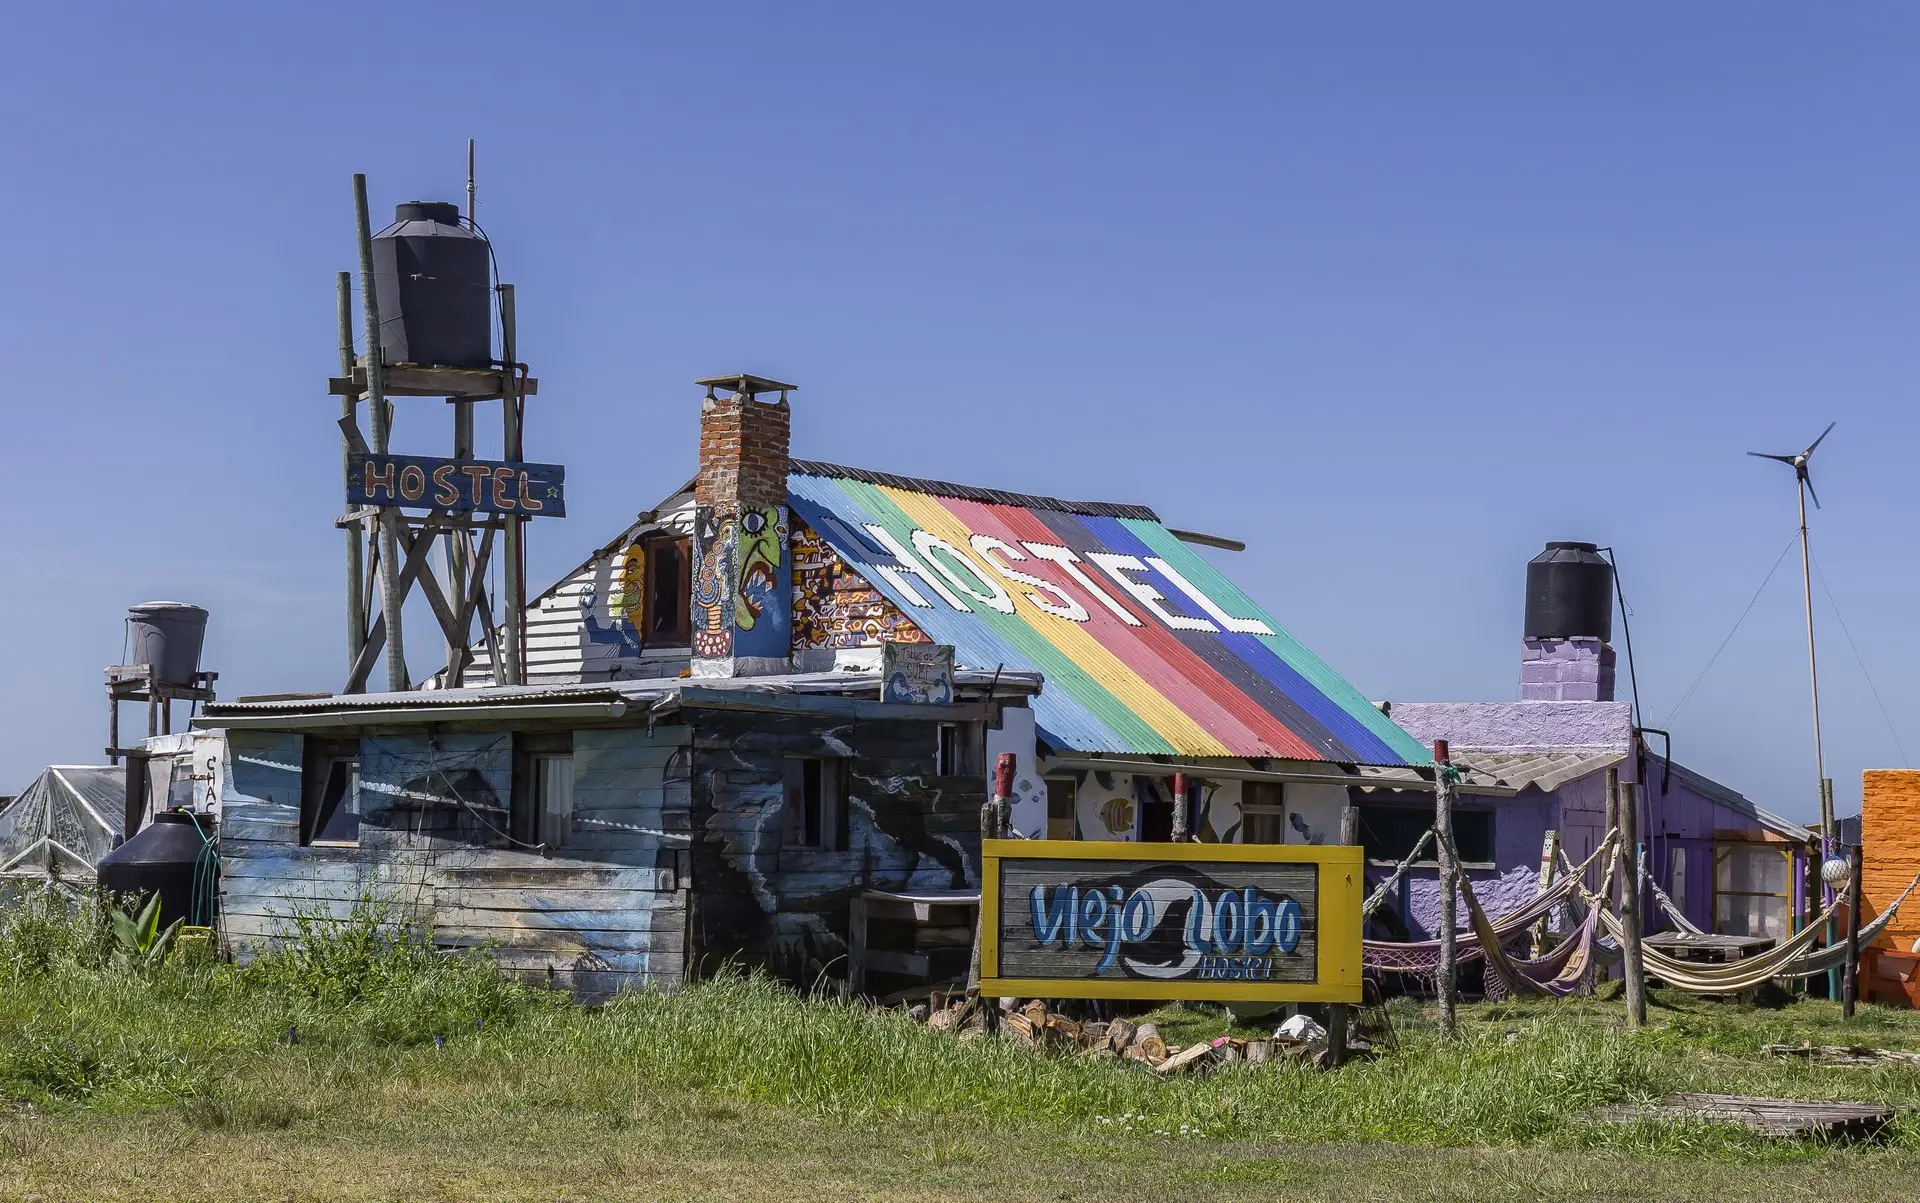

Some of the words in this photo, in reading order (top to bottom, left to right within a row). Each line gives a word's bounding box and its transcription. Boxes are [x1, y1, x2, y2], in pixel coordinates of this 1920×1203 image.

[365, 461, 543, 510] HOSTEL
[819, 515, 1277, 636] HOSTEL
[1184, 885, 1302, 955] Lobo
